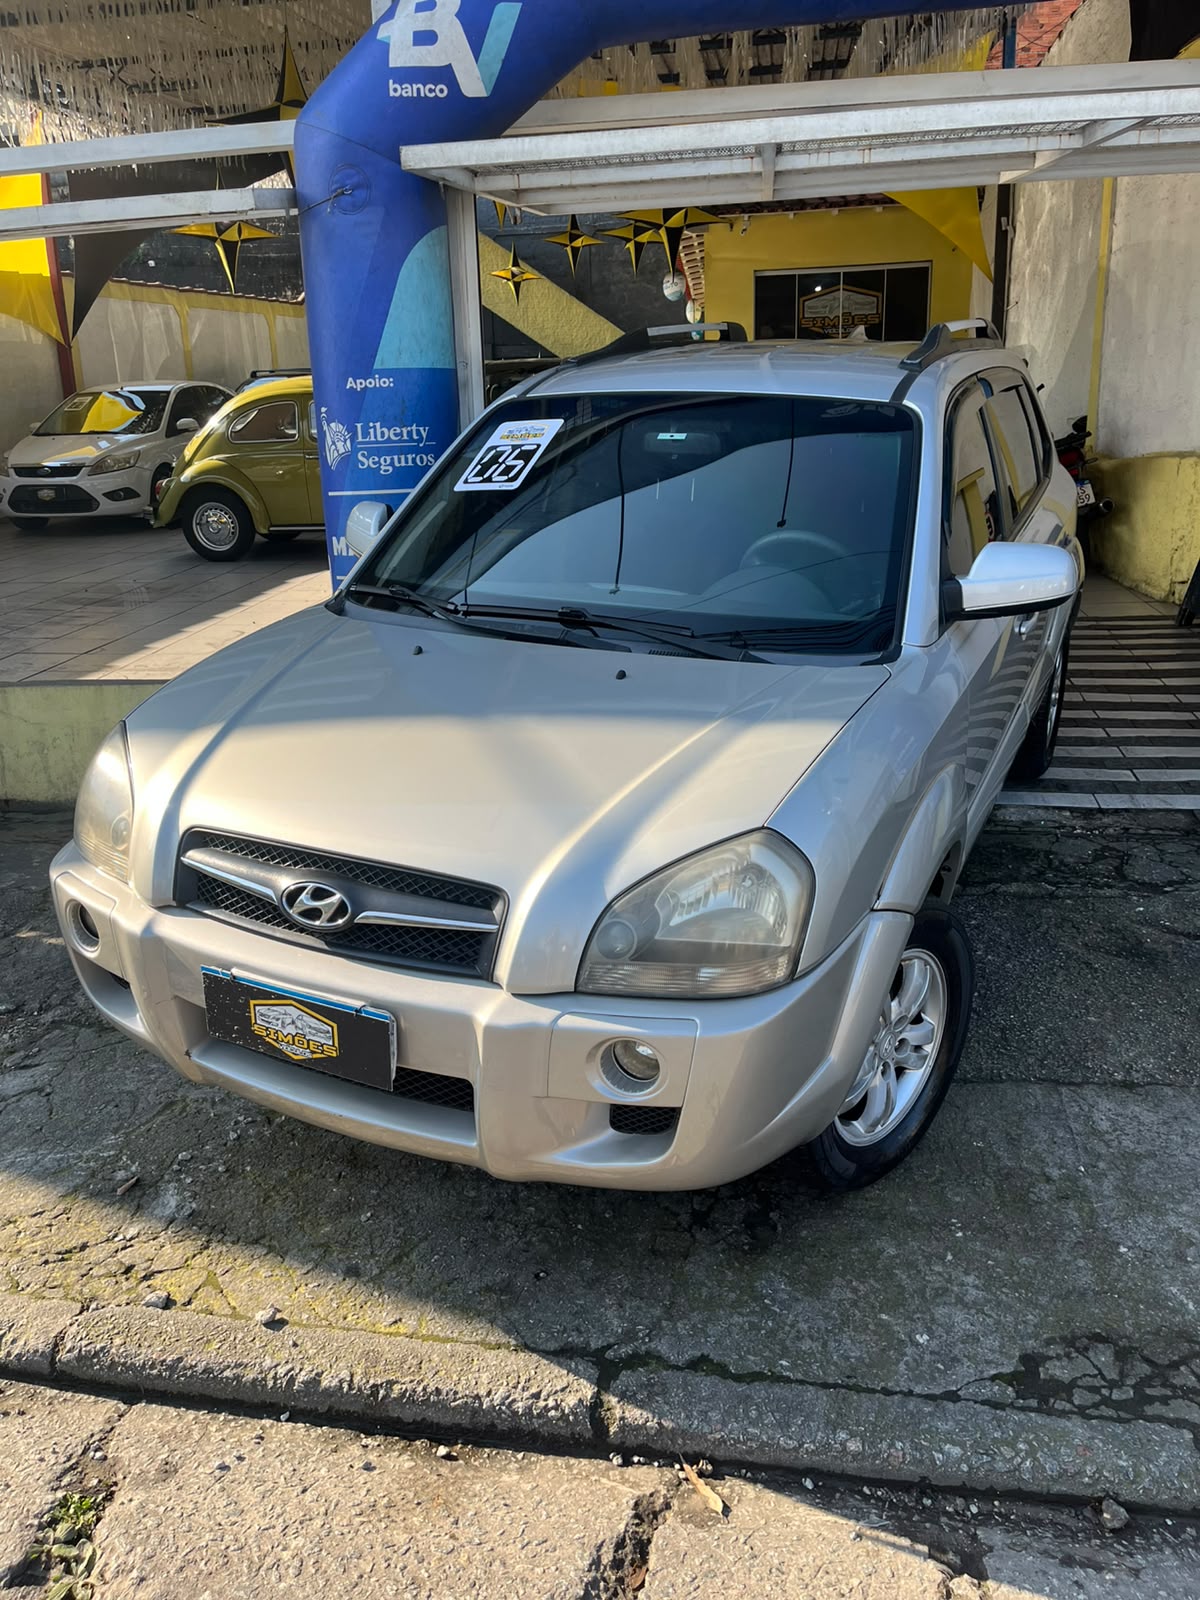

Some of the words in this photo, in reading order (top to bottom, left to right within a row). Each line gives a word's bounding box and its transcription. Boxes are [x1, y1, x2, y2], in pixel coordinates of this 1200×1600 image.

[389, 79, 448, 98] banco
[801, 312, 880, 328] SIMÕES
[346, 374, 394, 391] Apoio:
[355, 421, 430, 447] Liberty
[357, 450, 436, 475] Seguros
[467, 444, 538, 483] 06
[251, 1022, 338, 1059] SIMÕES
